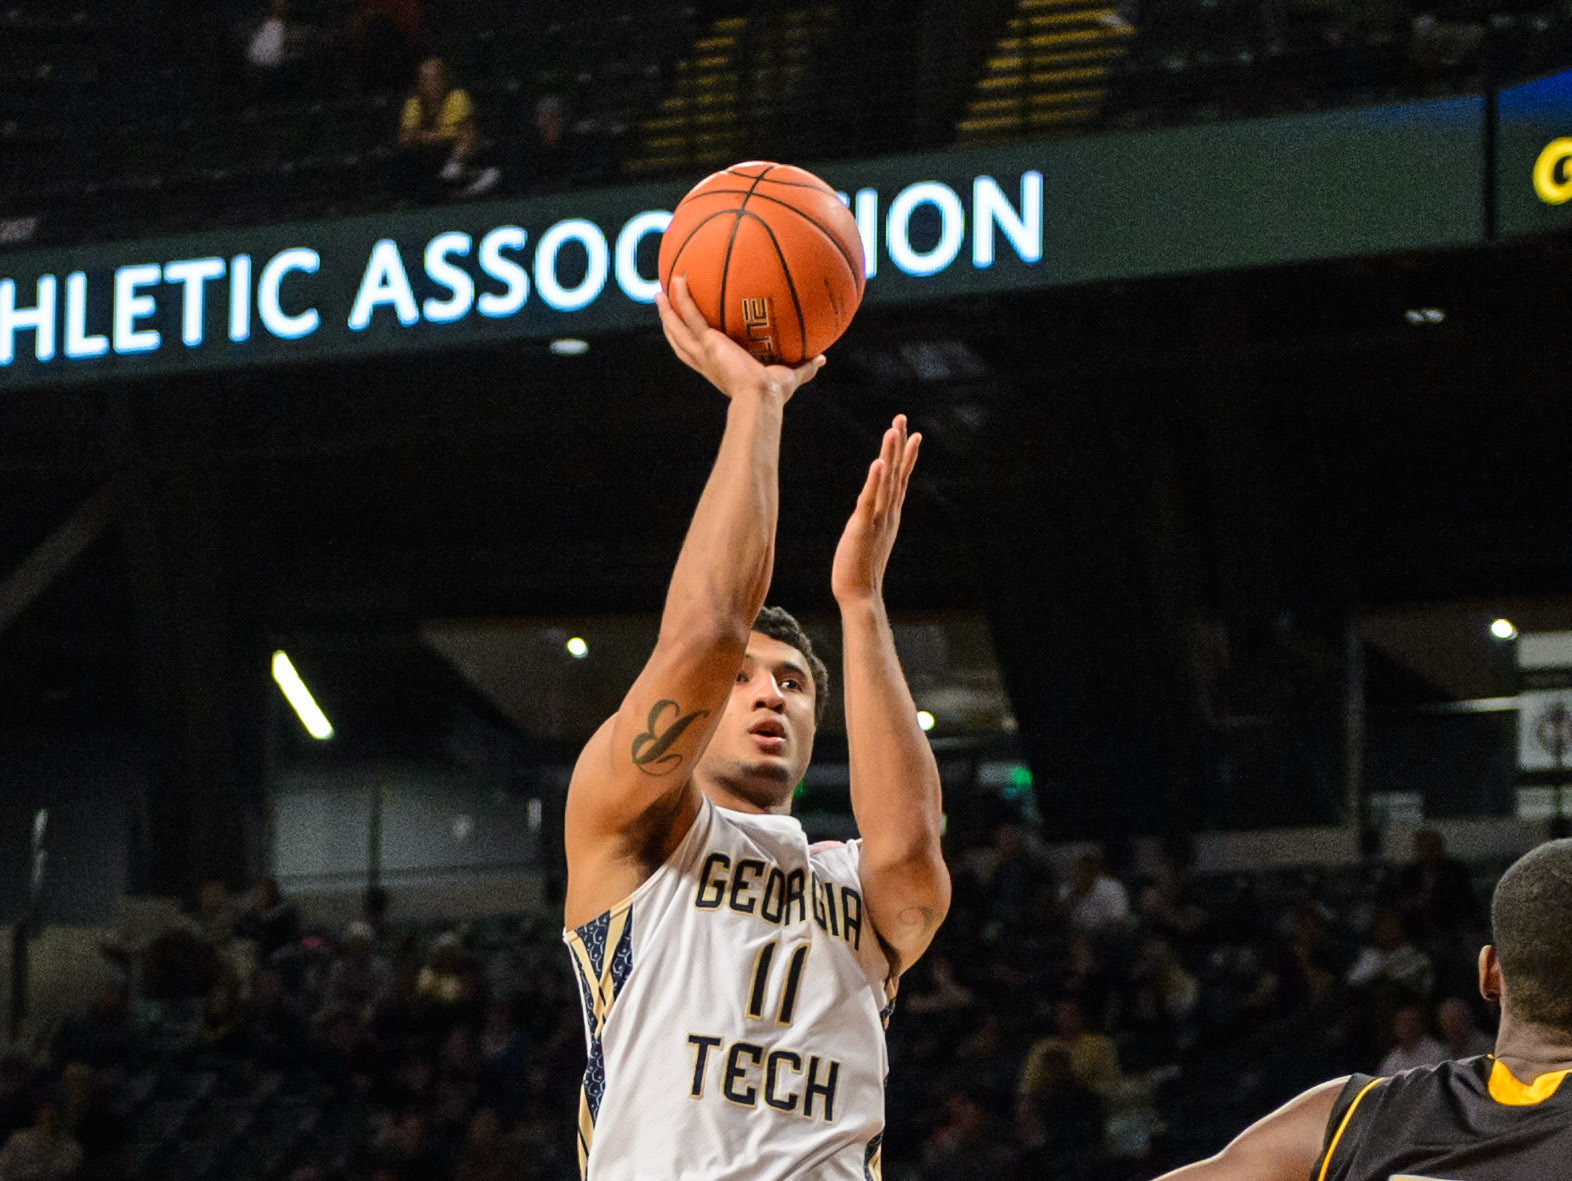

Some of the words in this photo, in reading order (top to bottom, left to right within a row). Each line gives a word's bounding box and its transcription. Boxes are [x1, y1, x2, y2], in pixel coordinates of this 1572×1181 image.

[694, 852, 863, 952] GEORGIA
[745, 938, 812, 1027] 11
[686, 1032, 842, 1124] TECH
